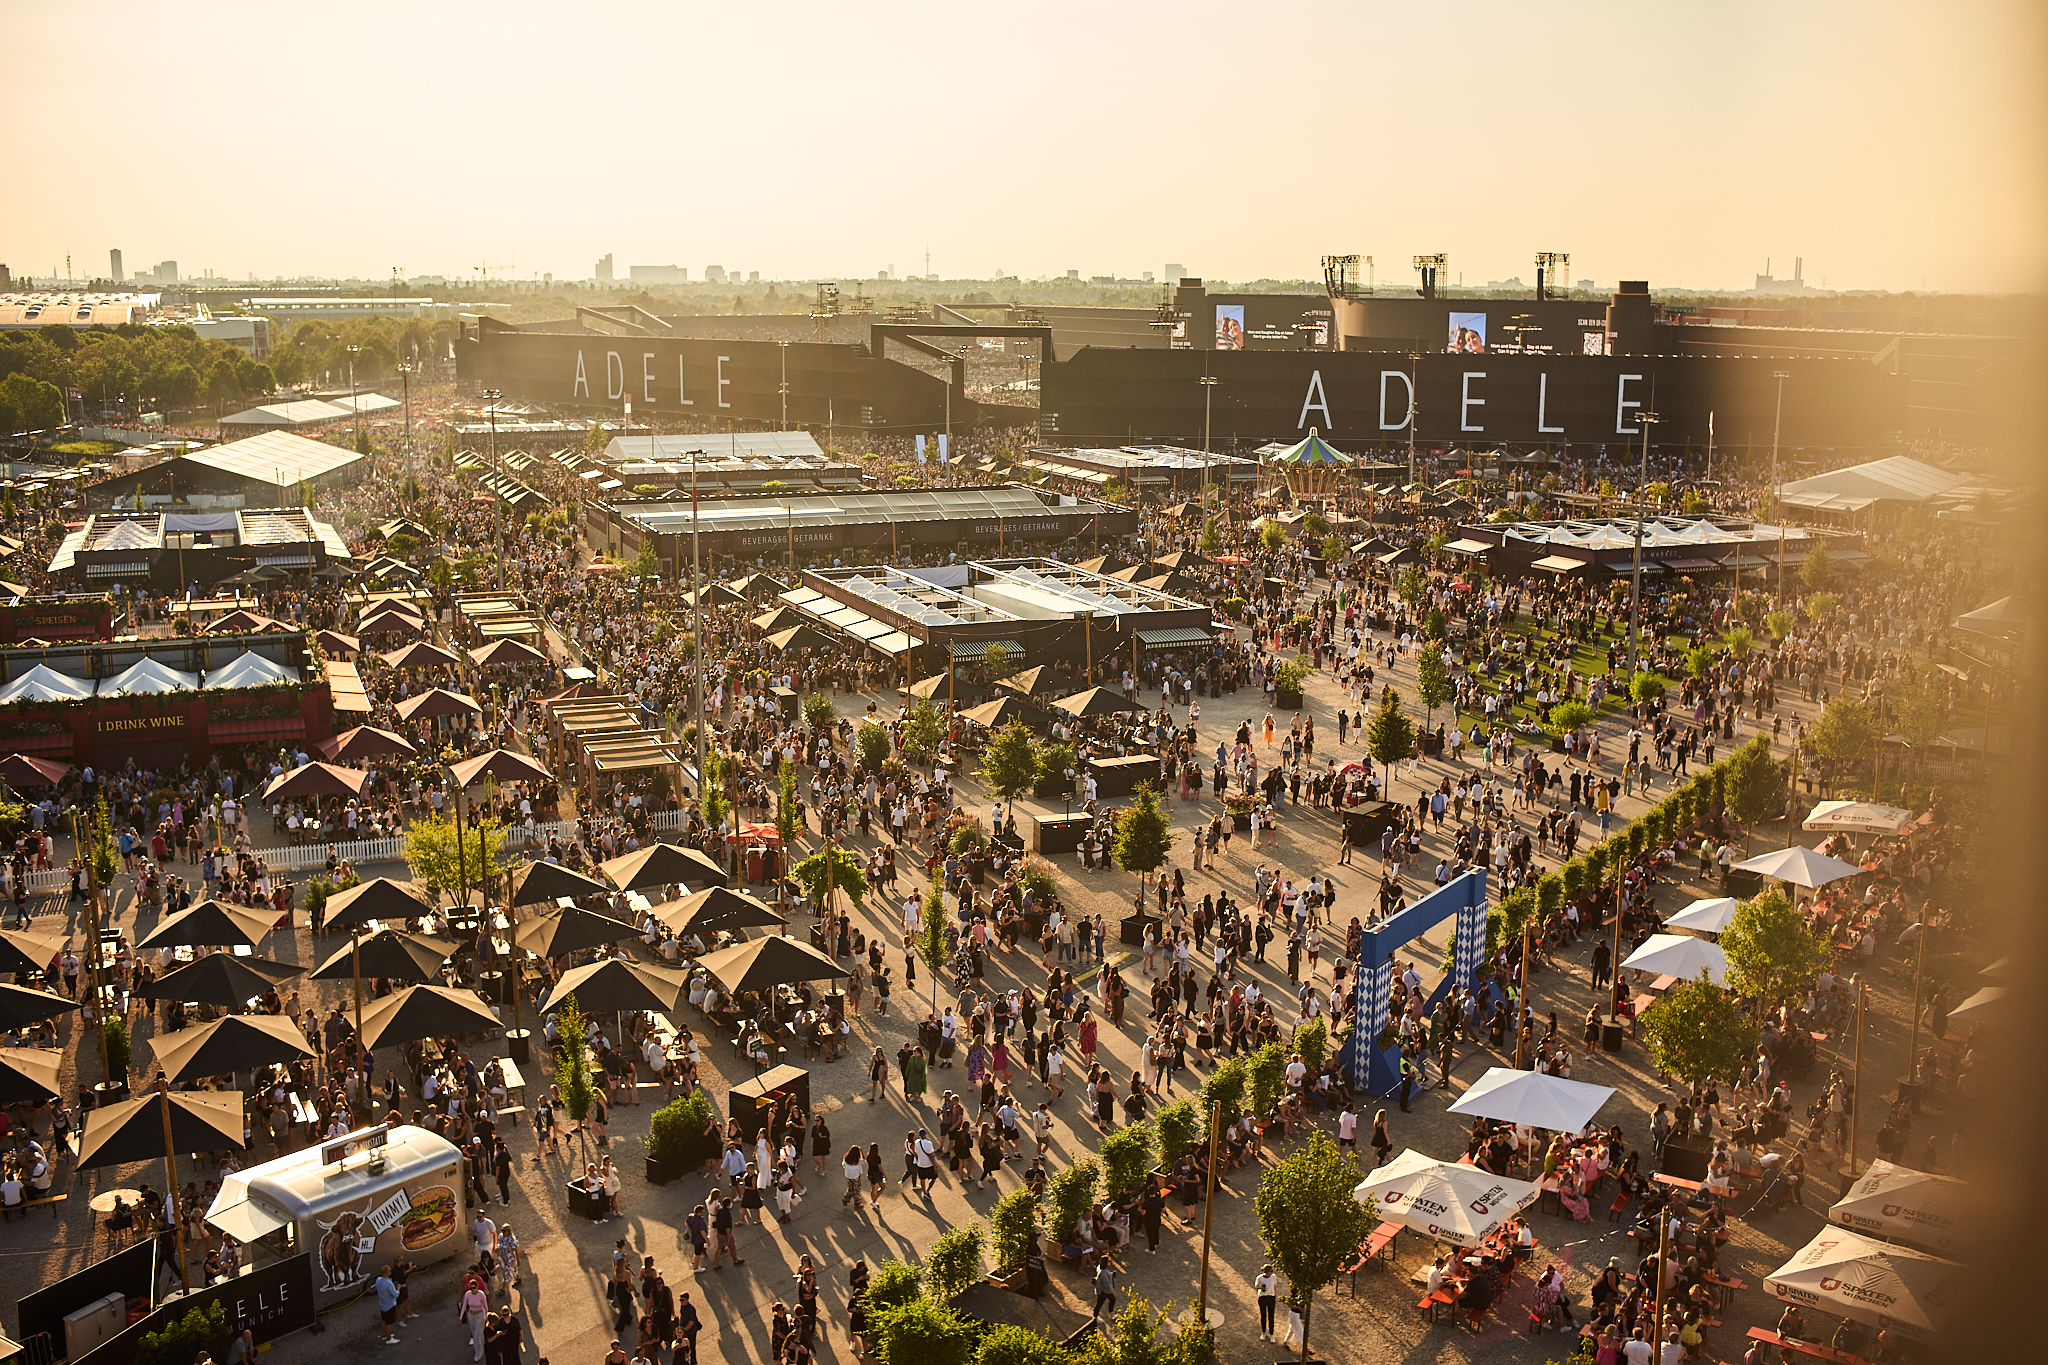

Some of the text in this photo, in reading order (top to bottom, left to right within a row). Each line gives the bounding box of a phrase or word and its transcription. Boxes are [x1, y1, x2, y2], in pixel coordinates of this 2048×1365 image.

[574, 350, 731, 408] ADELE
[1297, 370, 1643, 434] ADELE
[742, 535, 788, 546] BEVERAGES
[36, 615, 77, 625] SPEISEN
[97, 715, 184, 731] I DRINK WINE
[1402, 1194, 1448, 1213] SPATEN
[1479, 1184, 1504, 1204] SPATEN
[371, 1194, 407, 1230] YUMMY!
[1853, 1215, 1883, 1227] SPATEN
[1902, 1208, 1953, 1226] SPATEN
[1788, 1287, 1819, 1301] SPATEN
[1841, 1283, 1897, 1304] SPATEN
[226, 1306, 284, 1335] MUNICH
